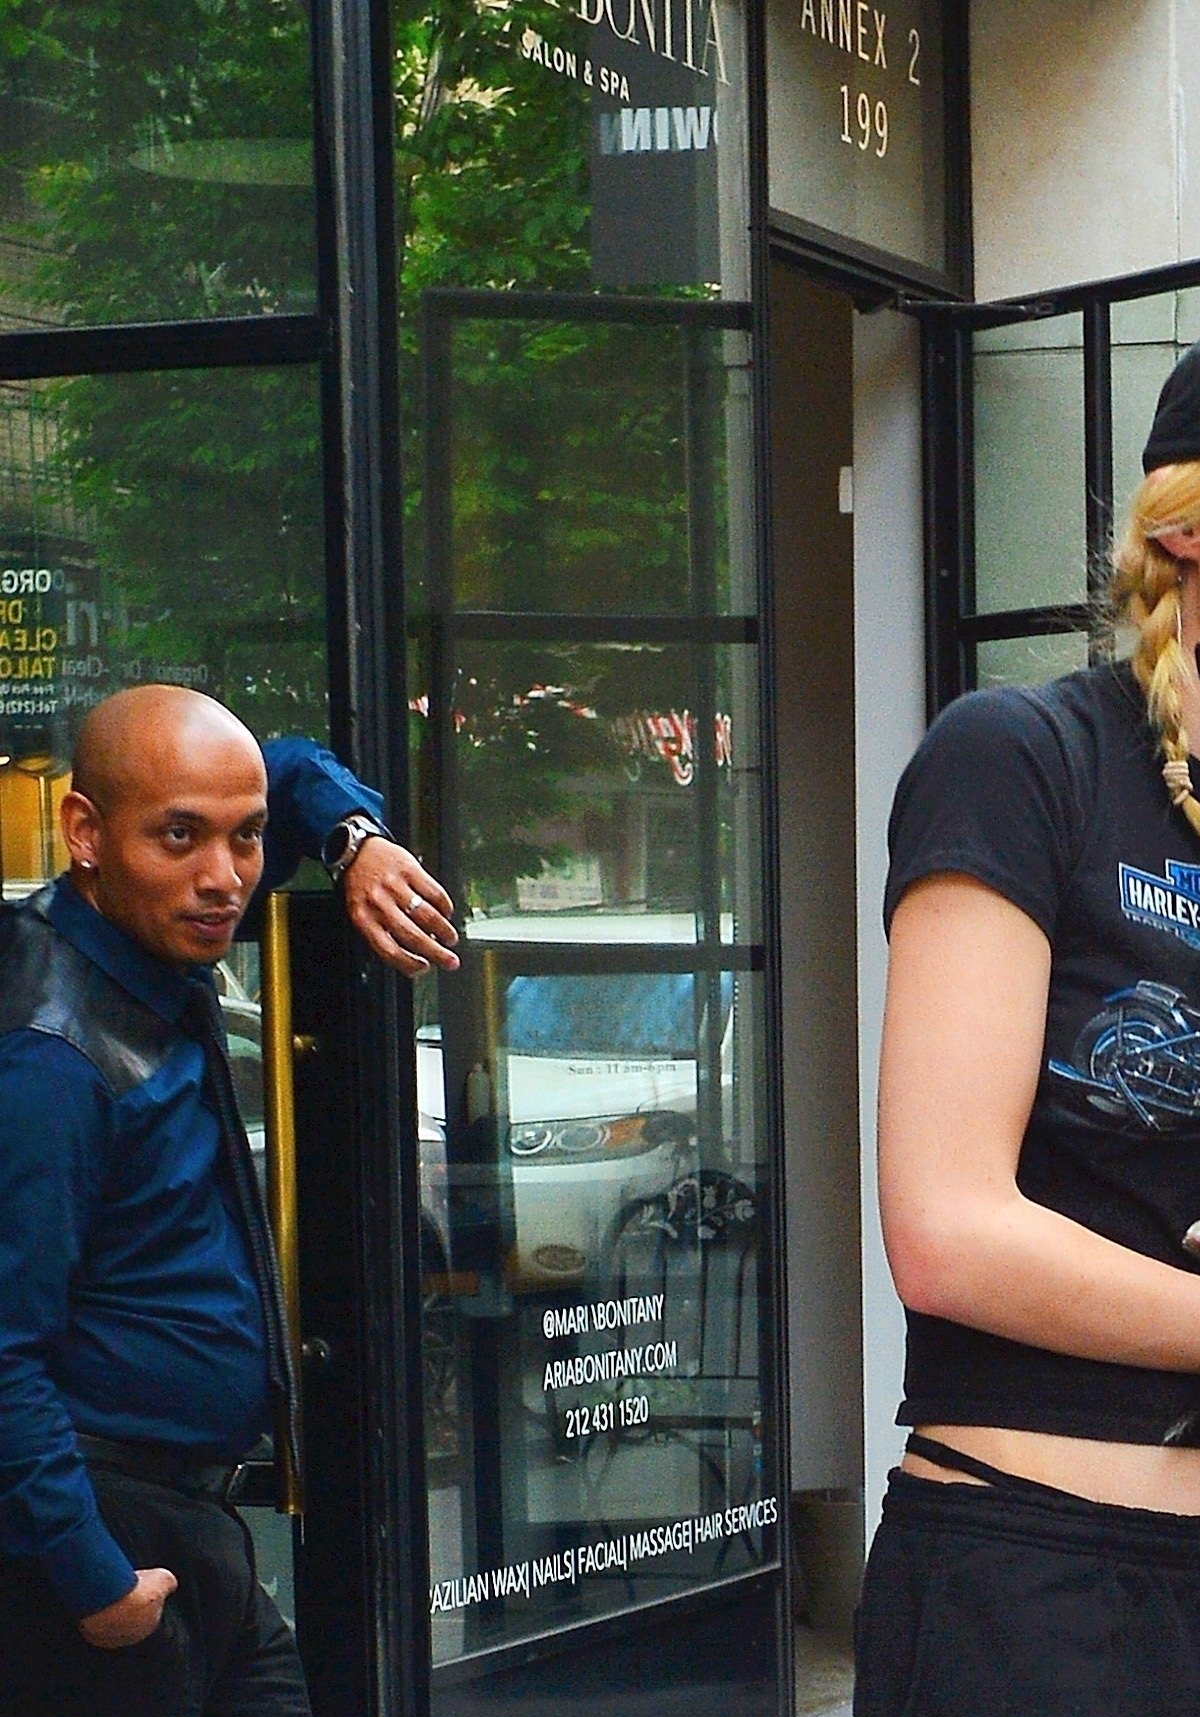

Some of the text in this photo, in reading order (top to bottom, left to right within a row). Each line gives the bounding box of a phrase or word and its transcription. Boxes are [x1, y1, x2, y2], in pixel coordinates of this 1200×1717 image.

[521, 30, 630, 103] SALON & SPA
[801, 0, 920, 86] ANNEX 2
[840, 85, 888, 158] 199
[565, 1395, 649, 1438] 212 431 1520
[429, 1571, 489, 1614] AZILIAN
[695, 1512, 722, 1544] HAIR
[724, 1497, 778, 1536] SERVICES
